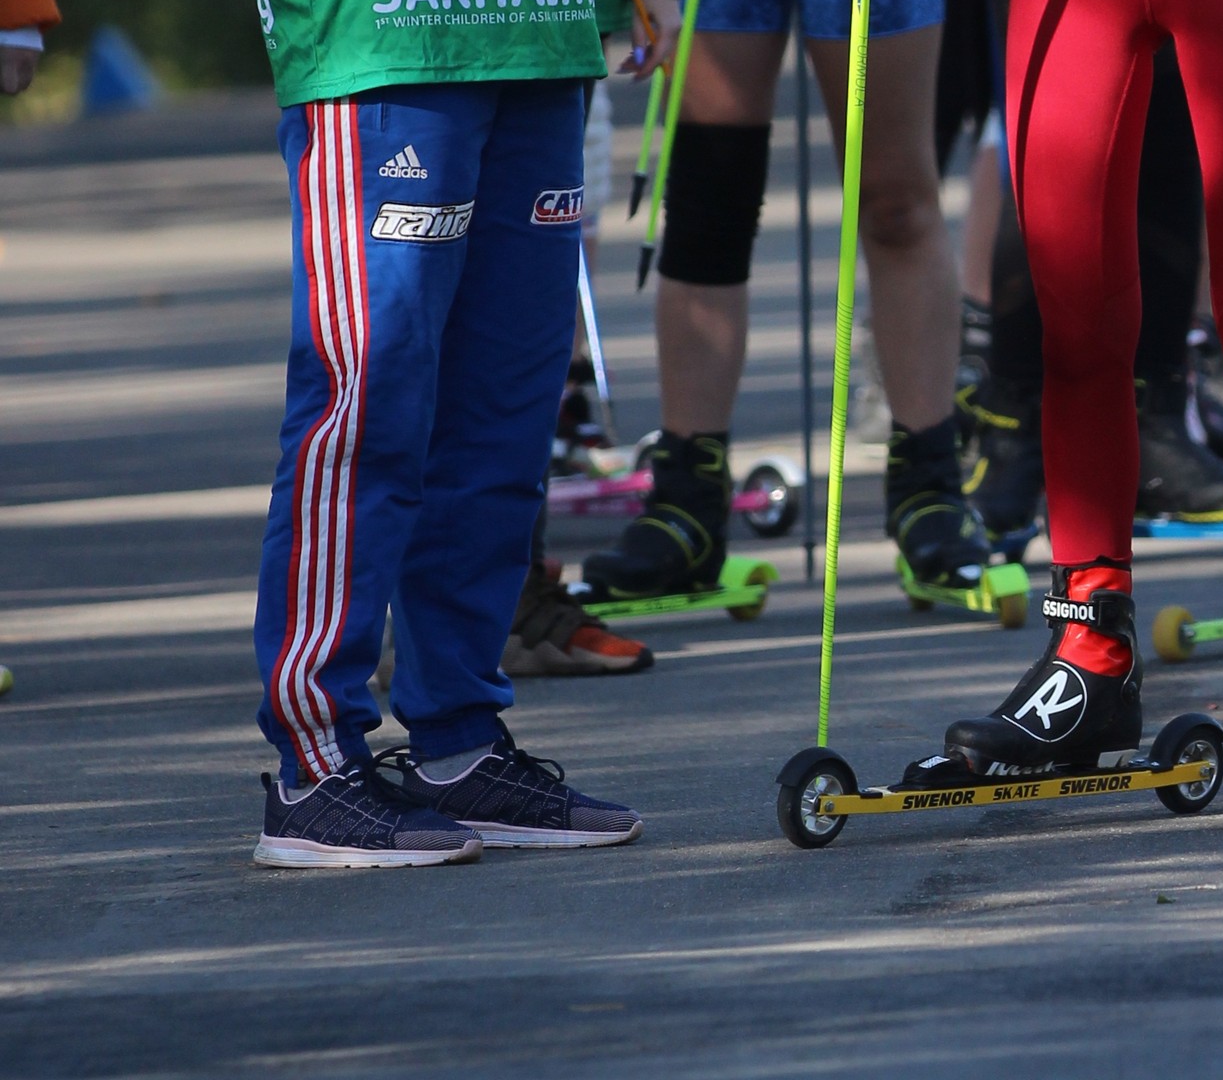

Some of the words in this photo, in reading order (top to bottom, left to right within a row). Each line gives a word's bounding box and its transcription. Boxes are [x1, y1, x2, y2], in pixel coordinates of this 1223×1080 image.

[375, 17, 390, 30] 1ST
[392, 14, 441, 29] WINTER
[444, 11, 505, 26] CHILDREN
[508, 11, 526, 23] OF
[378, 166, 428, 180] adidas
[902, 790, 976, 810] SWENOR
[993, 783, 1041, 801] SKATE
[1059, 775, 1132, 795] SWENOR
